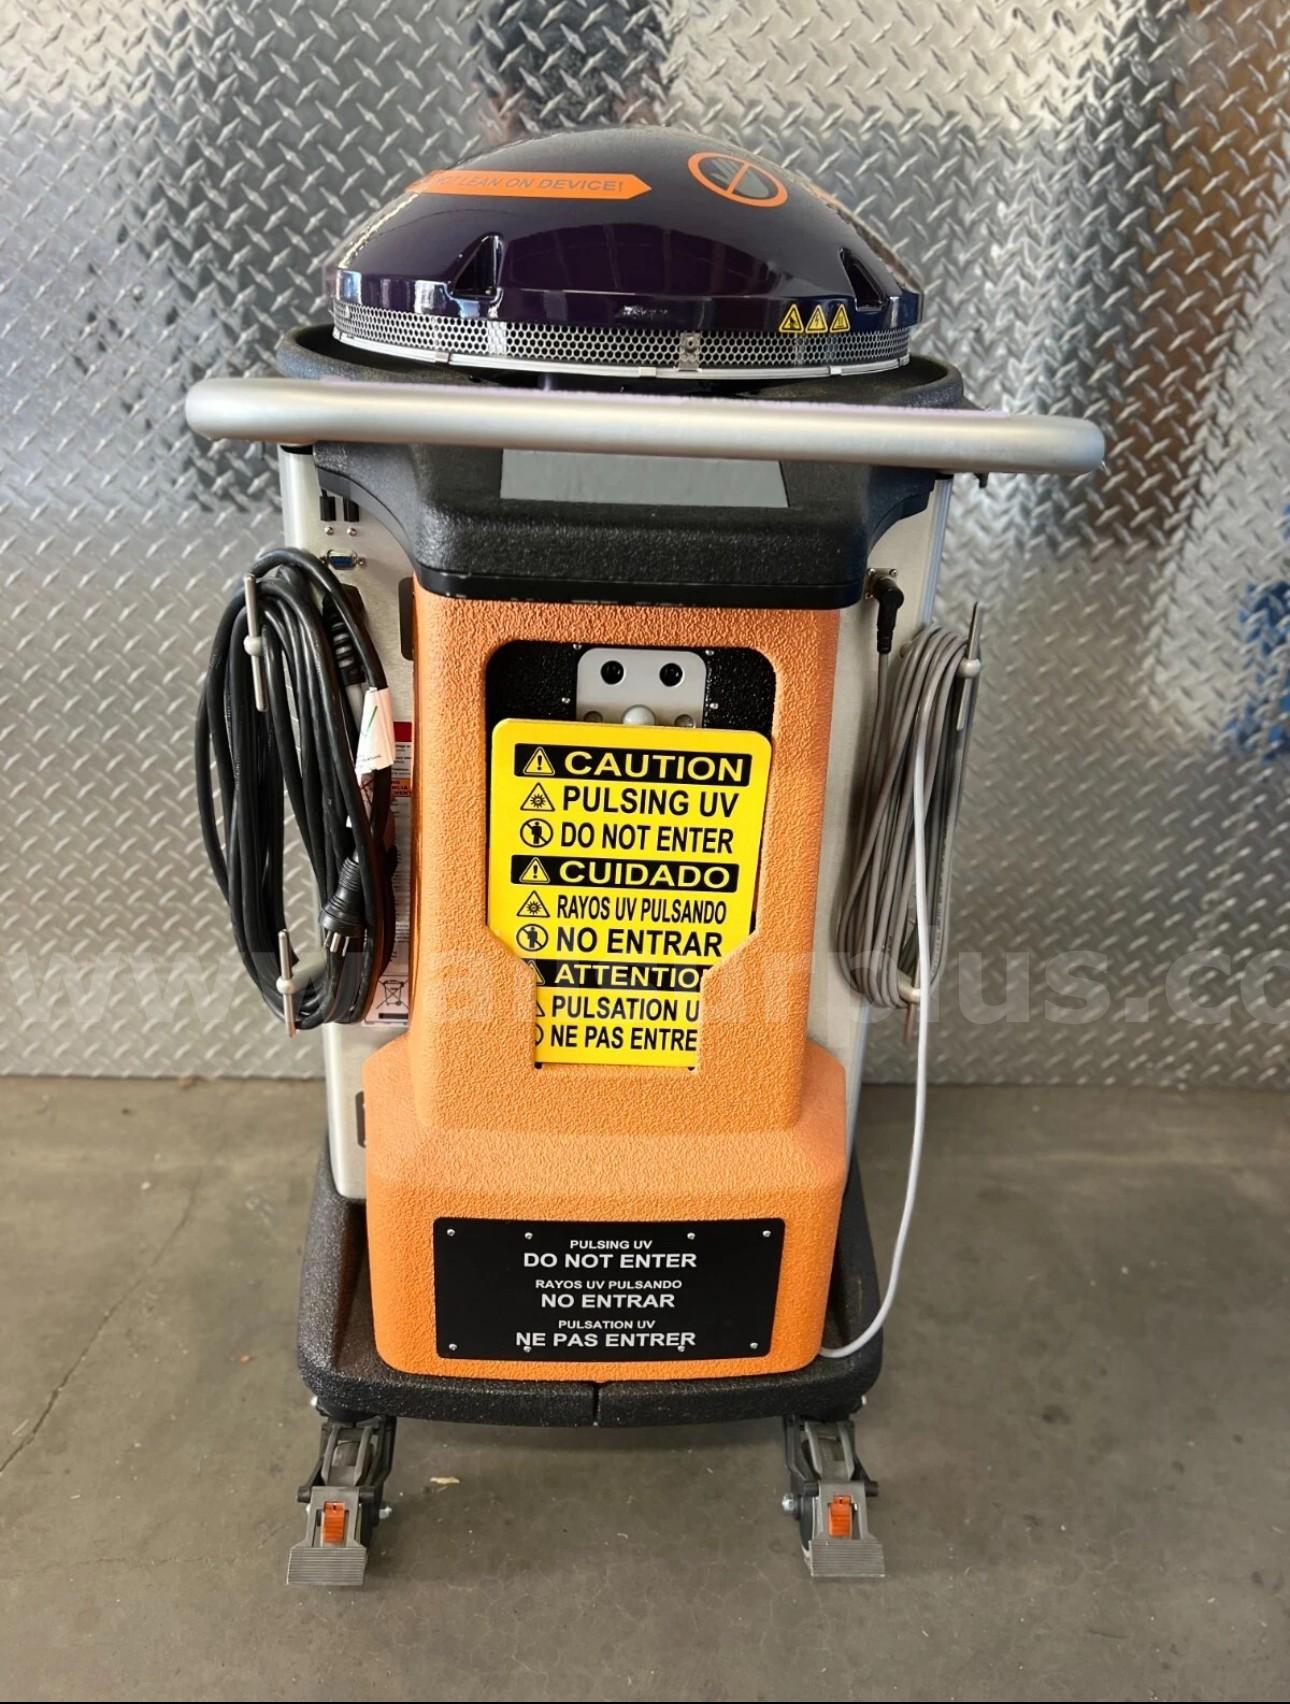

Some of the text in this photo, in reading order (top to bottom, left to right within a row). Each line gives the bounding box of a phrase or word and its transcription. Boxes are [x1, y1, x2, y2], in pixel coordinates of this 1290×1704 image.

[504, 177, 534, 189] ON
[537, 179, 624, 193] DEVICE!
[564, 751, 744, 782] CAUTION
[562, 785, 740, 818] PULSING UV
[561, 822, 734, 854] DO NOT ENTER
[559, 860, 730, 889] CUIDADO
[556, 894, 727, 925] RAYOS UV PULSANDO
[556, 926, 722, 958] NO ENTRAR
[554, 963, 706, 989] ATTENTIO
[551, 995, 701, 1023] PULSATION U
[550, 1025, 698, 1052] NE PAS ENTRE
[569, 1239, 653, 1250] PULSING UV
[523, 1253, 697, 1269] DO NOT ENTER
[535, 1279, 682, 1290] RAYOS UV PULSANDO
[541, 1293, 675, 1308] NO ENTRAR
[558, 1320, 656, 1329] PULSATION UV
[516, 1331, 696, 1347] NE PAS ENTRER
